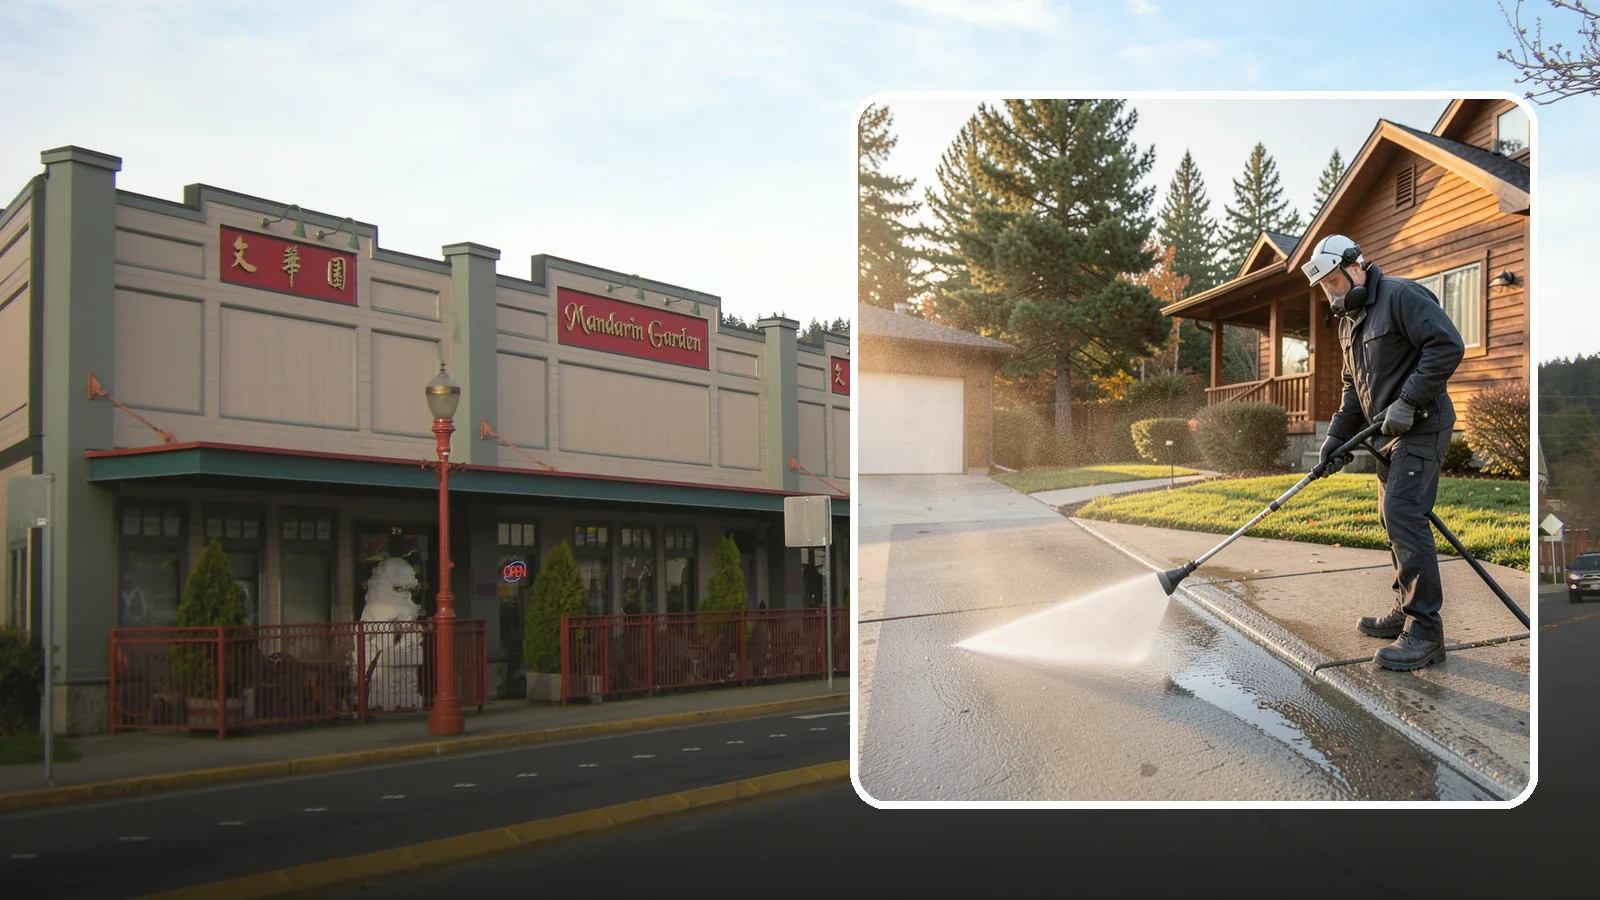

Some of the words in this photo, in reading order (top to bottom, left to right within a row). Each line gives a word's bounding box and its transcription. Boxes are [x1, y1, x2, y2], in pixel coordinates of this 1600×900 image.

[231, 236, 346, 291] 文華園
[565, 303, 644, 340] Mandarin
[648, 320, 701, 352] Garden
[503, 565, 527, 579] OPEN
